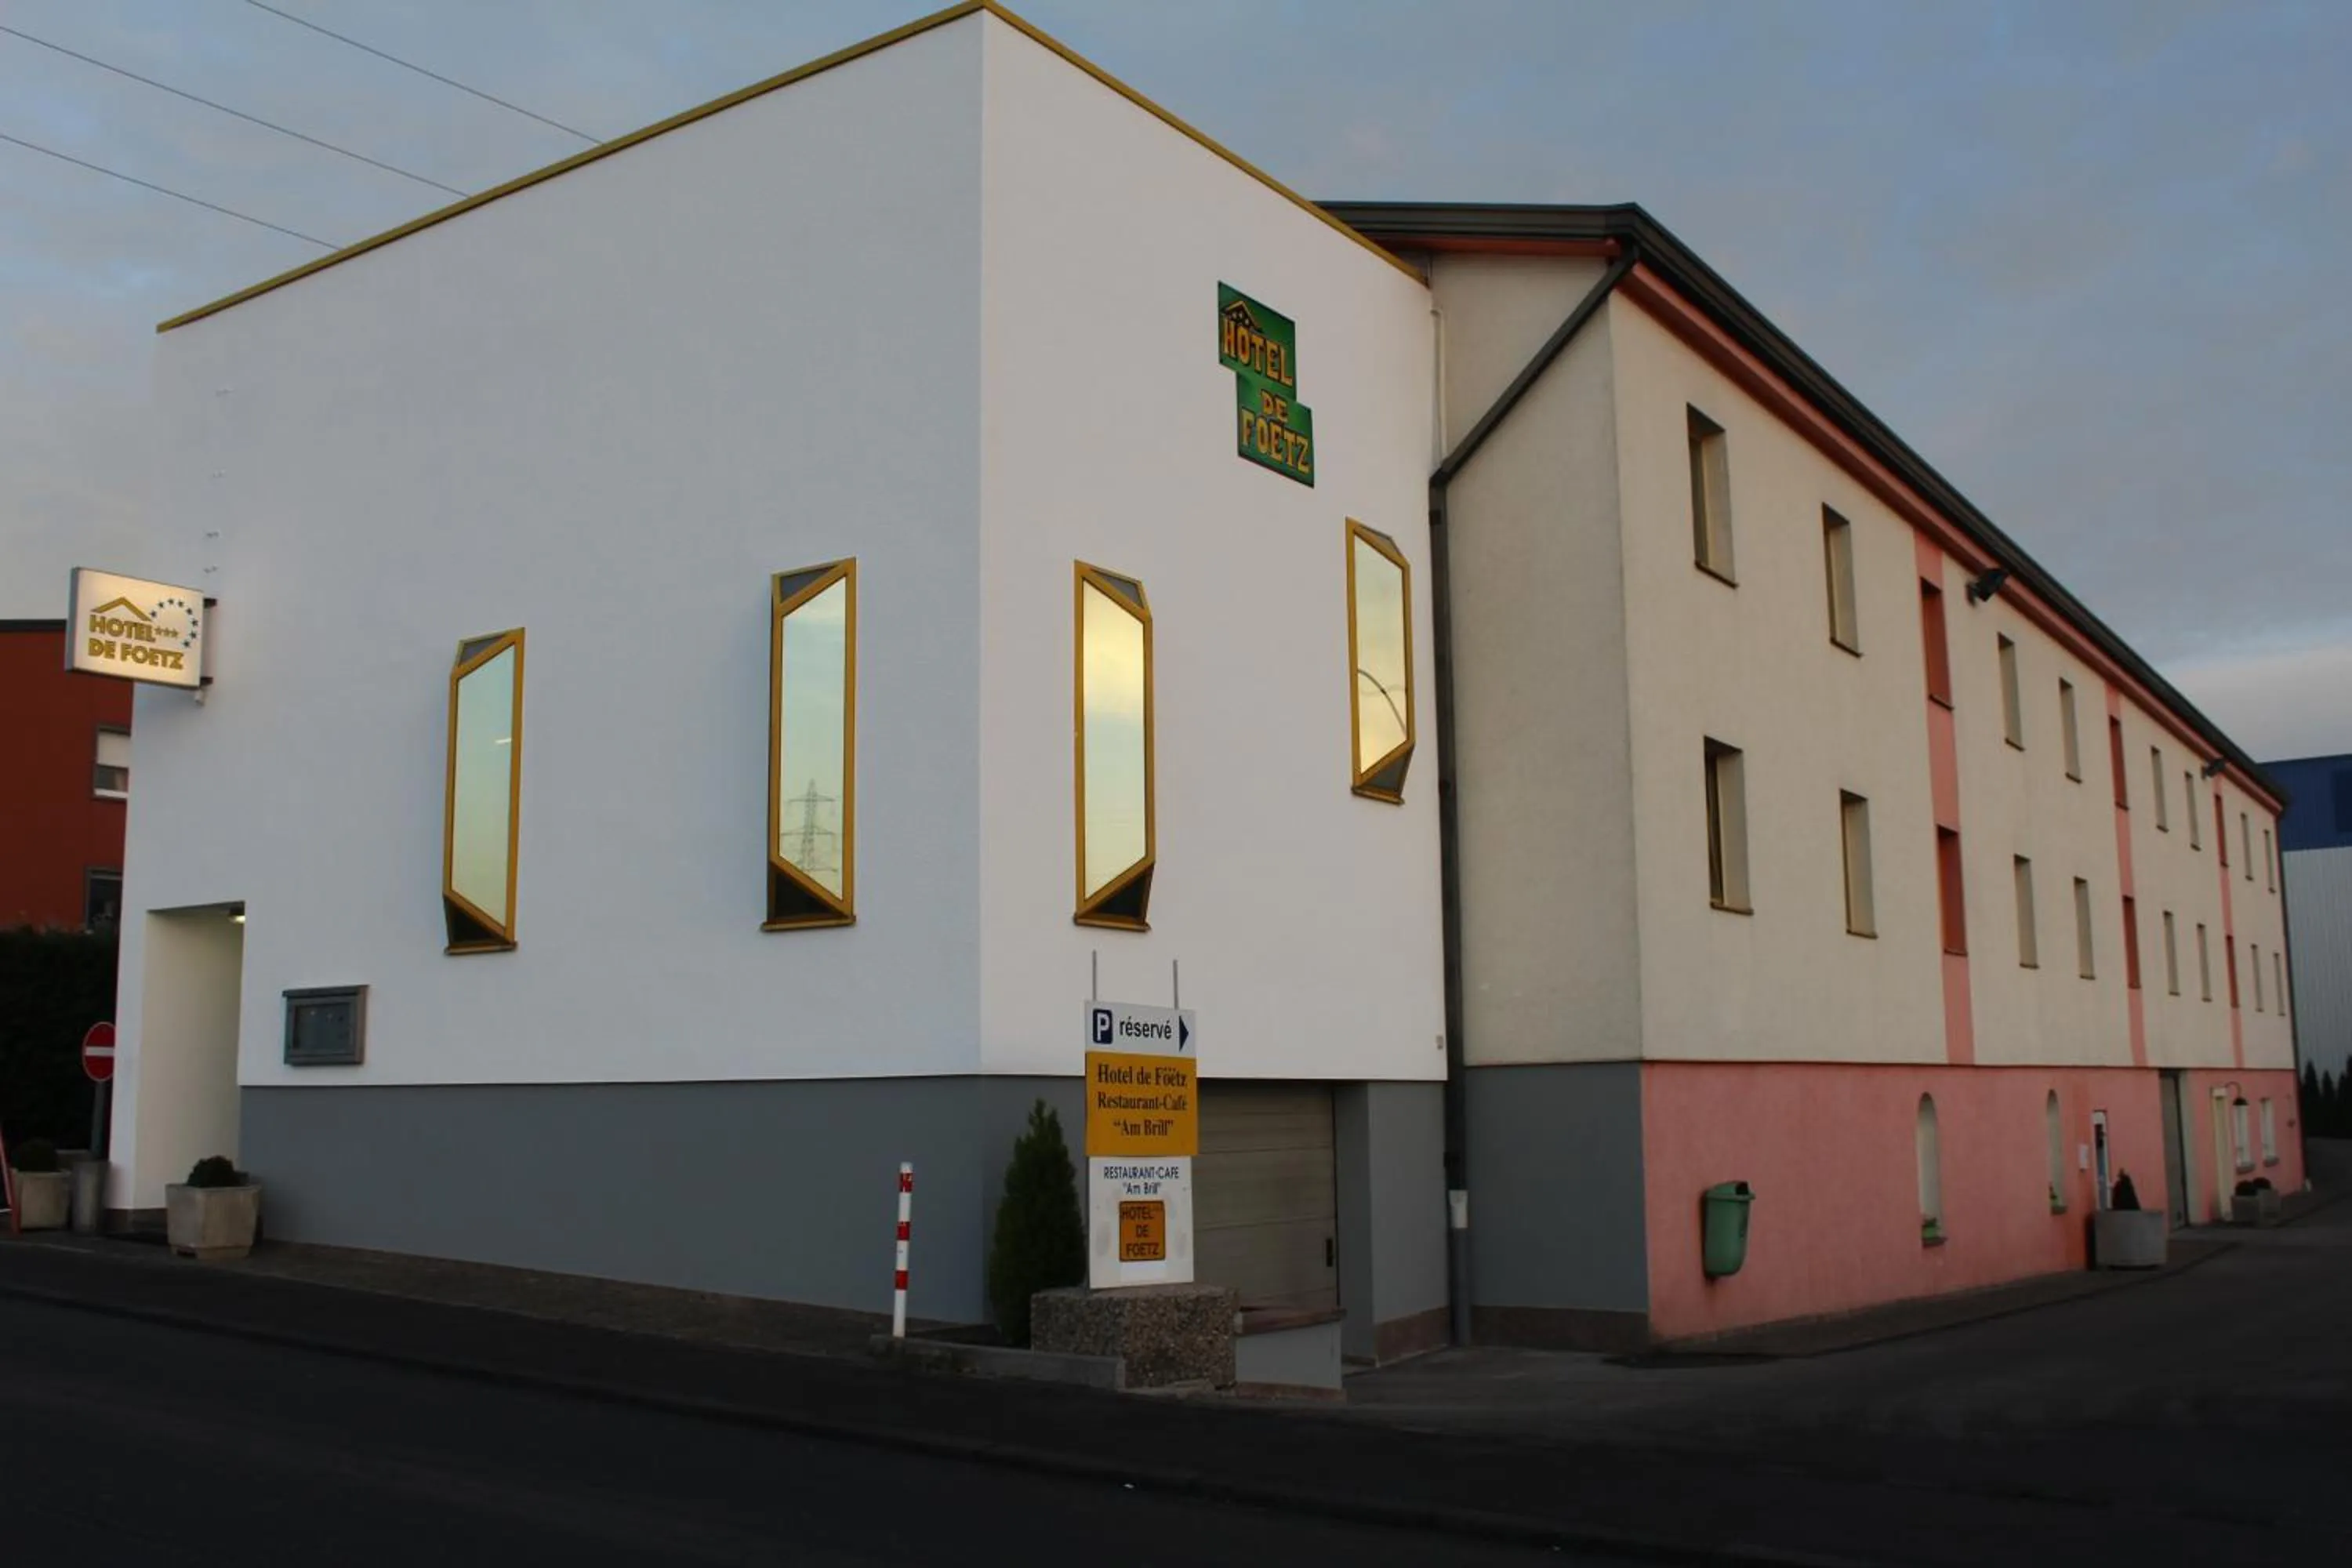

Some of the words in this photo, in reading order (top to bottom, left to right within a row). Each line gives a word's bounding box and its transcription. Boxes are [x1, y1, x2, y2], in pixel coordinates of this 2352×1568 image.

[1222, 317, 1294, 387] HOTEL
[1261, 389, 1288, 423] DE
[1240, 407, 1312, 474] FOETZ
[89, 614, 156, 643] HOTEL
[87, 637, 117, 660] DE
[120, 641, 185, 670] FOETZ
[1097, 1011, 1110, 1041] P
[1119, 1015, 1172, 1040] réservé
[1098, 1063, 1133, 1085] Hotel
[1136, 1065, 1152, 1086] de
[1121, 1205, 1155, 1221] HOTEL
[1135, 1224, 1149, 1238] DE
[1125, 1242, 1160, 1257] FOETZ
